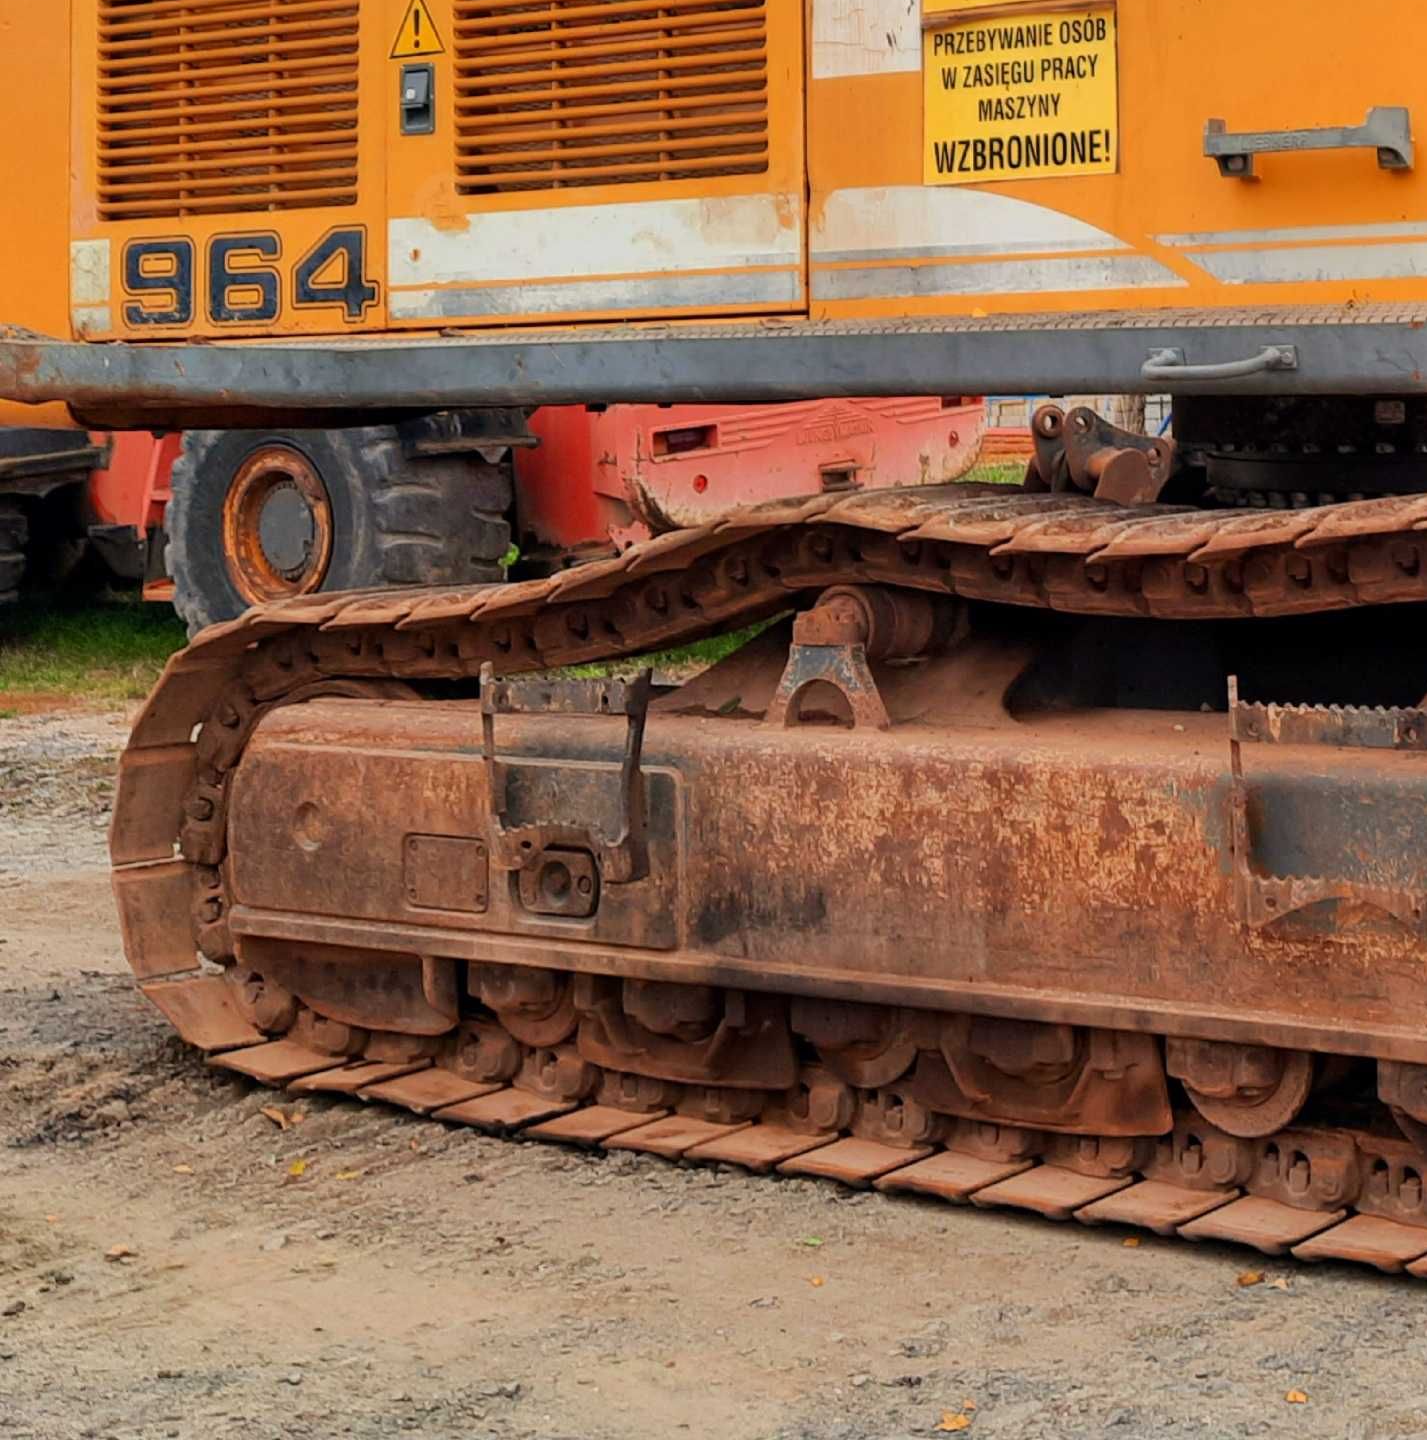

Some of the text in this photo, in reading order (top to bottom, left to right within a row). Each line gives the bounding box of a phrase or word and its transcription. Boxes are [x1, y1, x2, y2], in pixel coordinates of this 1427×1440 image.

[933, 13, 1107, 57] PRZEBYWANIE OSÓB
[942, 54, 1099, 92] W ZASIĘGU PRACY
[978, 93, 1061, 122] MASZYNY
[934, 128, 1111, 175] WZBRONIONE!
[121, 224, 380, 331] 964
